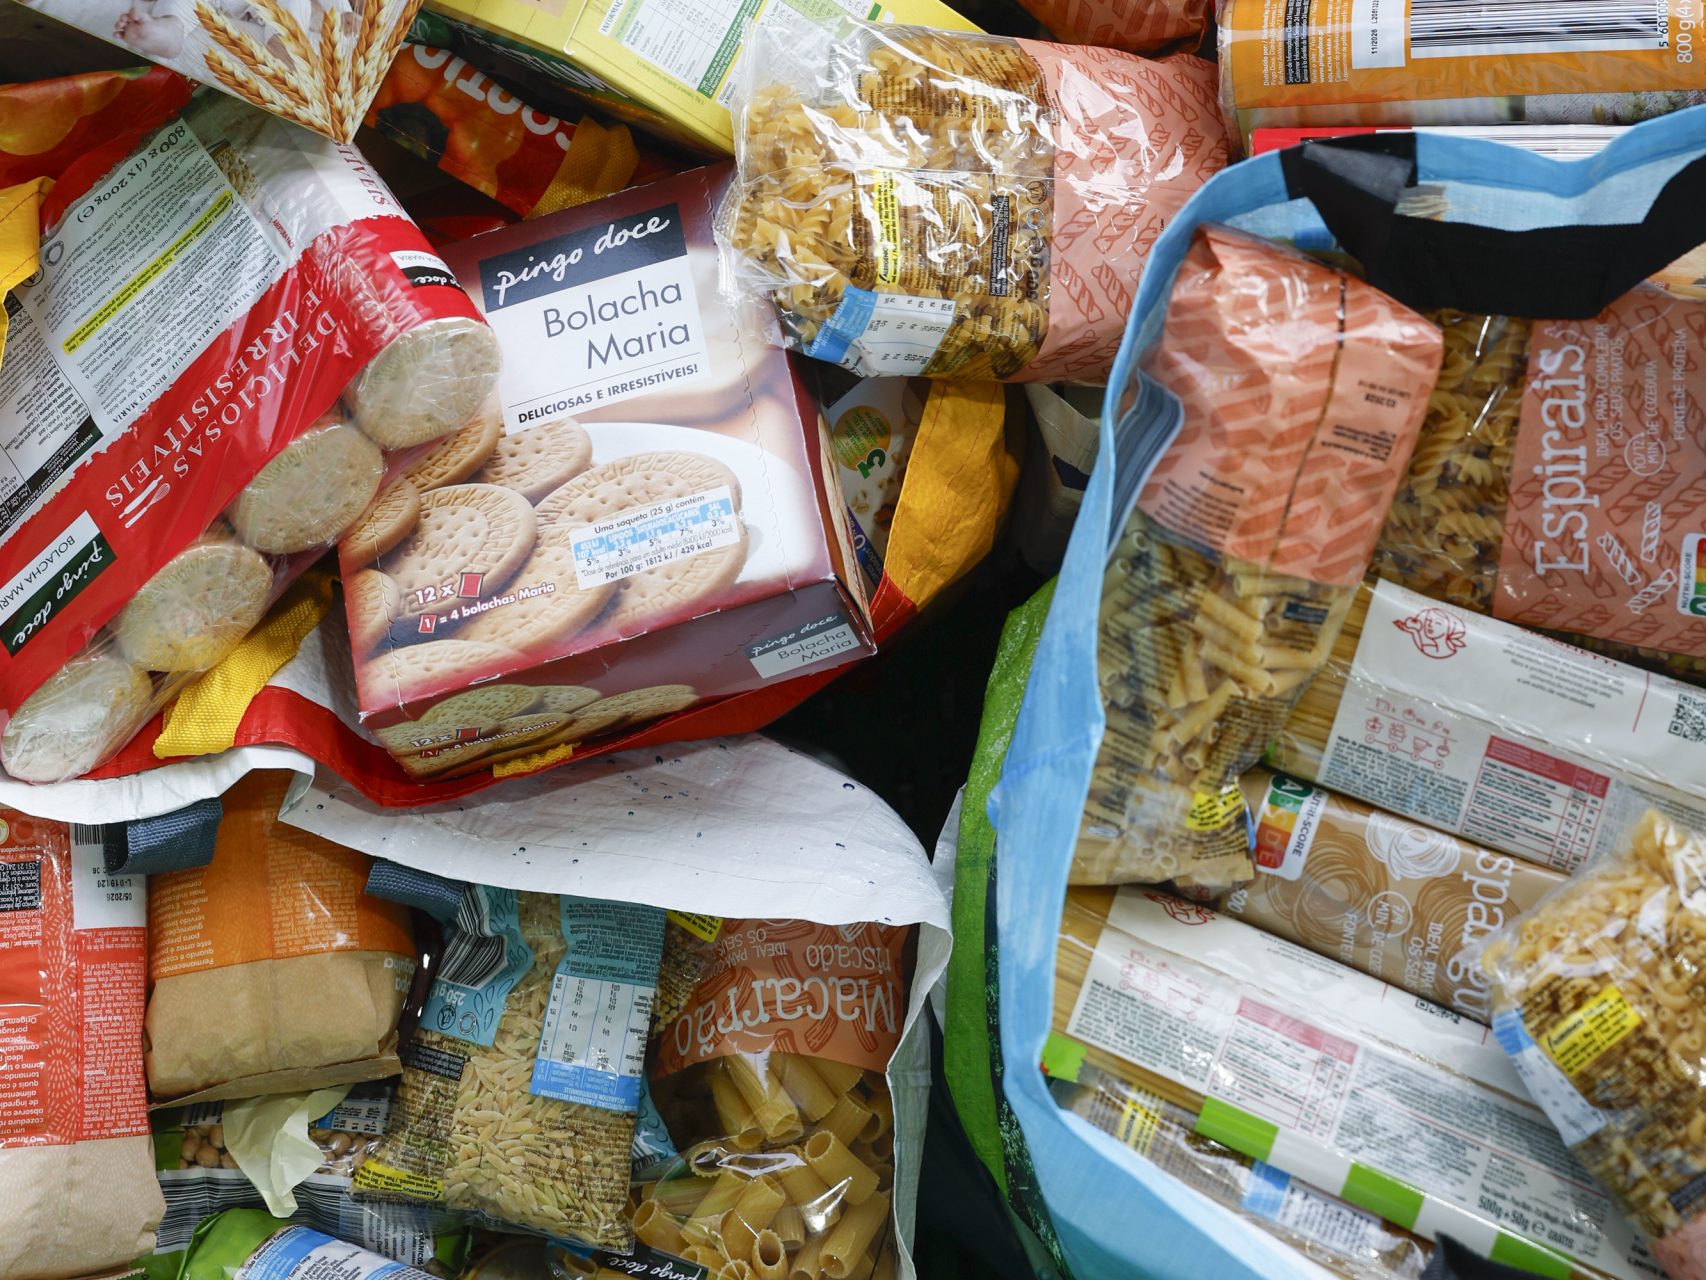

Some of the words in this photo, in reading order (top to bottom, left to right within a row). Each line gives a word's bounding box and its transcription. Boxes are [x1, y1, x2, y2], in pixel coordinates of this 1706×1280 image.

[1676, 33, 1693, 63] 800
[162, 126, 186, 153] 800
[494, 247, 582, 305] pingo
[594, 216, 670, 254] doce
[302, 290, 322, 312] E
[543, 280, 682, 338] Bolacha
[587, 321, 690, 370] Maria
[1595, 324, 1608, 388] COMPLETAR
[1672, 328, 1686, 386] PROTEÍNA
[173, 310, 337, 478] DELICIOSAS
[518, 393, 593, 424] DELICIOSAS
[597, 389, 604, 400] E
[608, 363, 699, 397] IRRESISTÍVEIS!
[1612, 388, 1622, 419] SEUS
[1648, 360, 1658, 419] COZEDURA
[1675, 390, 1685, 402] DE
[104, 311, 300, 507] IRRESISTÍVEIS
[1597, 391, 1608, 425] PARA
[1613, 426, 1622, 440] OS
[1649, 424, 1659, 438] DE
[1675, 410, 1685, 440] FONTE
[1533, 342, 1599, 575] Espirais
[1597, 430, 1608, 457] IDEAL
[594, 523, 614, 534] Uma
[616, 512, 648, 529] saqueta
[650, 506, 663, 519] (25
[676, 495, 705, 508] contém
[32, 535, 76, 581] BOLACHA
[56, 541, 104, 599] pingo
[605, 571, 618, 579] Por
[620, 565, 634, 575] 100
[645, 557, 662, 567] 1812
[664, 553, 673, 564] kJ
[681, 545, 695, 555] 429
[697, 540, 712, 551] kcal
[416, 587, 436, 606] 12
[441, 584, 455, 597] x
[1681, 552, 1692, 608] NUTRI-SCORE
[450, 609, 460, 620] 4
[462, 595, 516, 618] bolachas
[518, 582, 556, 600] Maria
[12, 602, 51, 647] doce
[751, 631, 796, 656] pingo
[800, 615, 838, 633] doce
[778, 631, 847, 659] Bolacha
[801, 639, 852, 663] Maria
[464, 731, 518, 747] bolachas
[521, 720, 559, 733] Maria
[750, 928, 767, 943] OS
[1341, 913, 1357, 952] FONTE
[1376, 930, 1387, 948] DE
[1410, 936, 1424, 957] OS
[1430, 921, 1444, 952] IDEAL
[160, 957, 215, 973] Permanecendo
[186, 948, 214, 960] quando
[725, 948, 748, 968] PARA
[754, 942, 788, 958] IDEAL
[806, 944, 891, 975] riscado
[1421, 955, 1438, 986] PARA
[446, 991, 467, 1007] 250
[675, 976, 897, 1057] Macarrão
[10, 1116, 43, 1125] cozedura
[13, 1108, 43, 1116] absorve
[1478, 1196, 1503, 1218] 500g
[609, 1257, 648, 1276] doce
